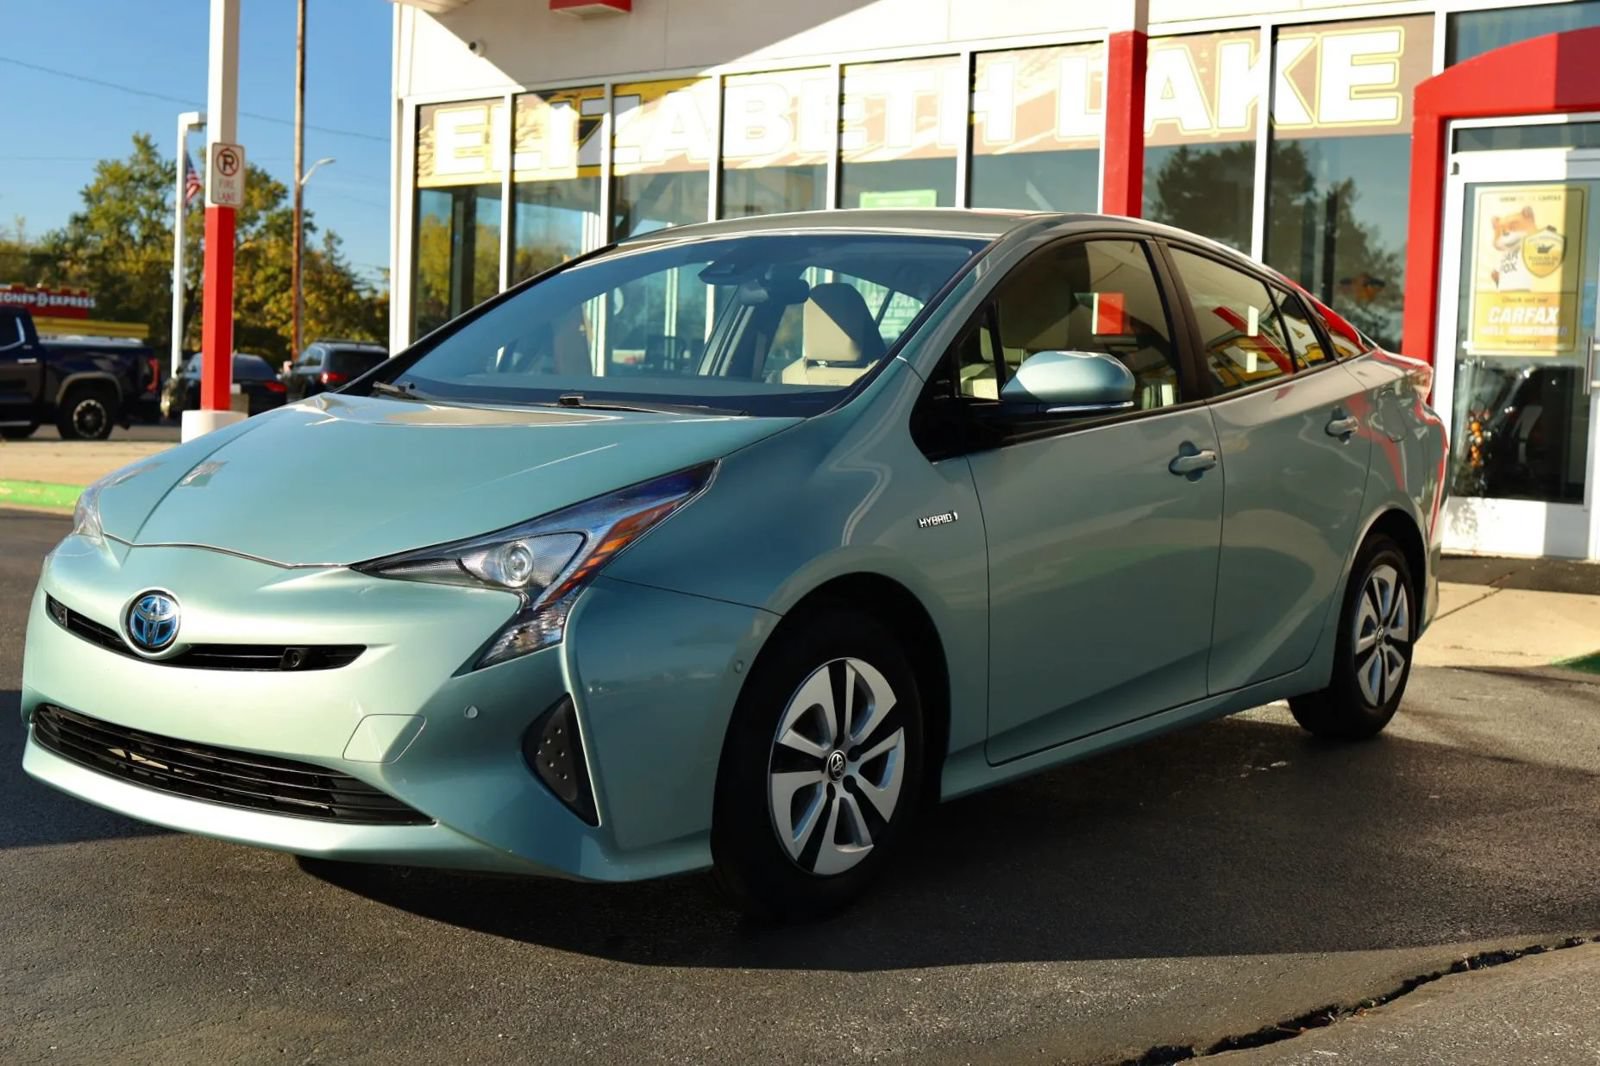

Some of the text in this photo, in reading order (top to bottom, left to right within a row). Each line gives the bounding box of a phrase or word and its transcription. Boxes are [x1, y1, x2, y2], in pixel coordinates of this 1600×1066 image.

[434, 26, 1404, 177] ELIZABETH LAKE
[49, 295, 96, 308] EXPRESS
[1488, 306, 1560, 325] CARFAX
[919, 512, 953, 528] HYBRID
